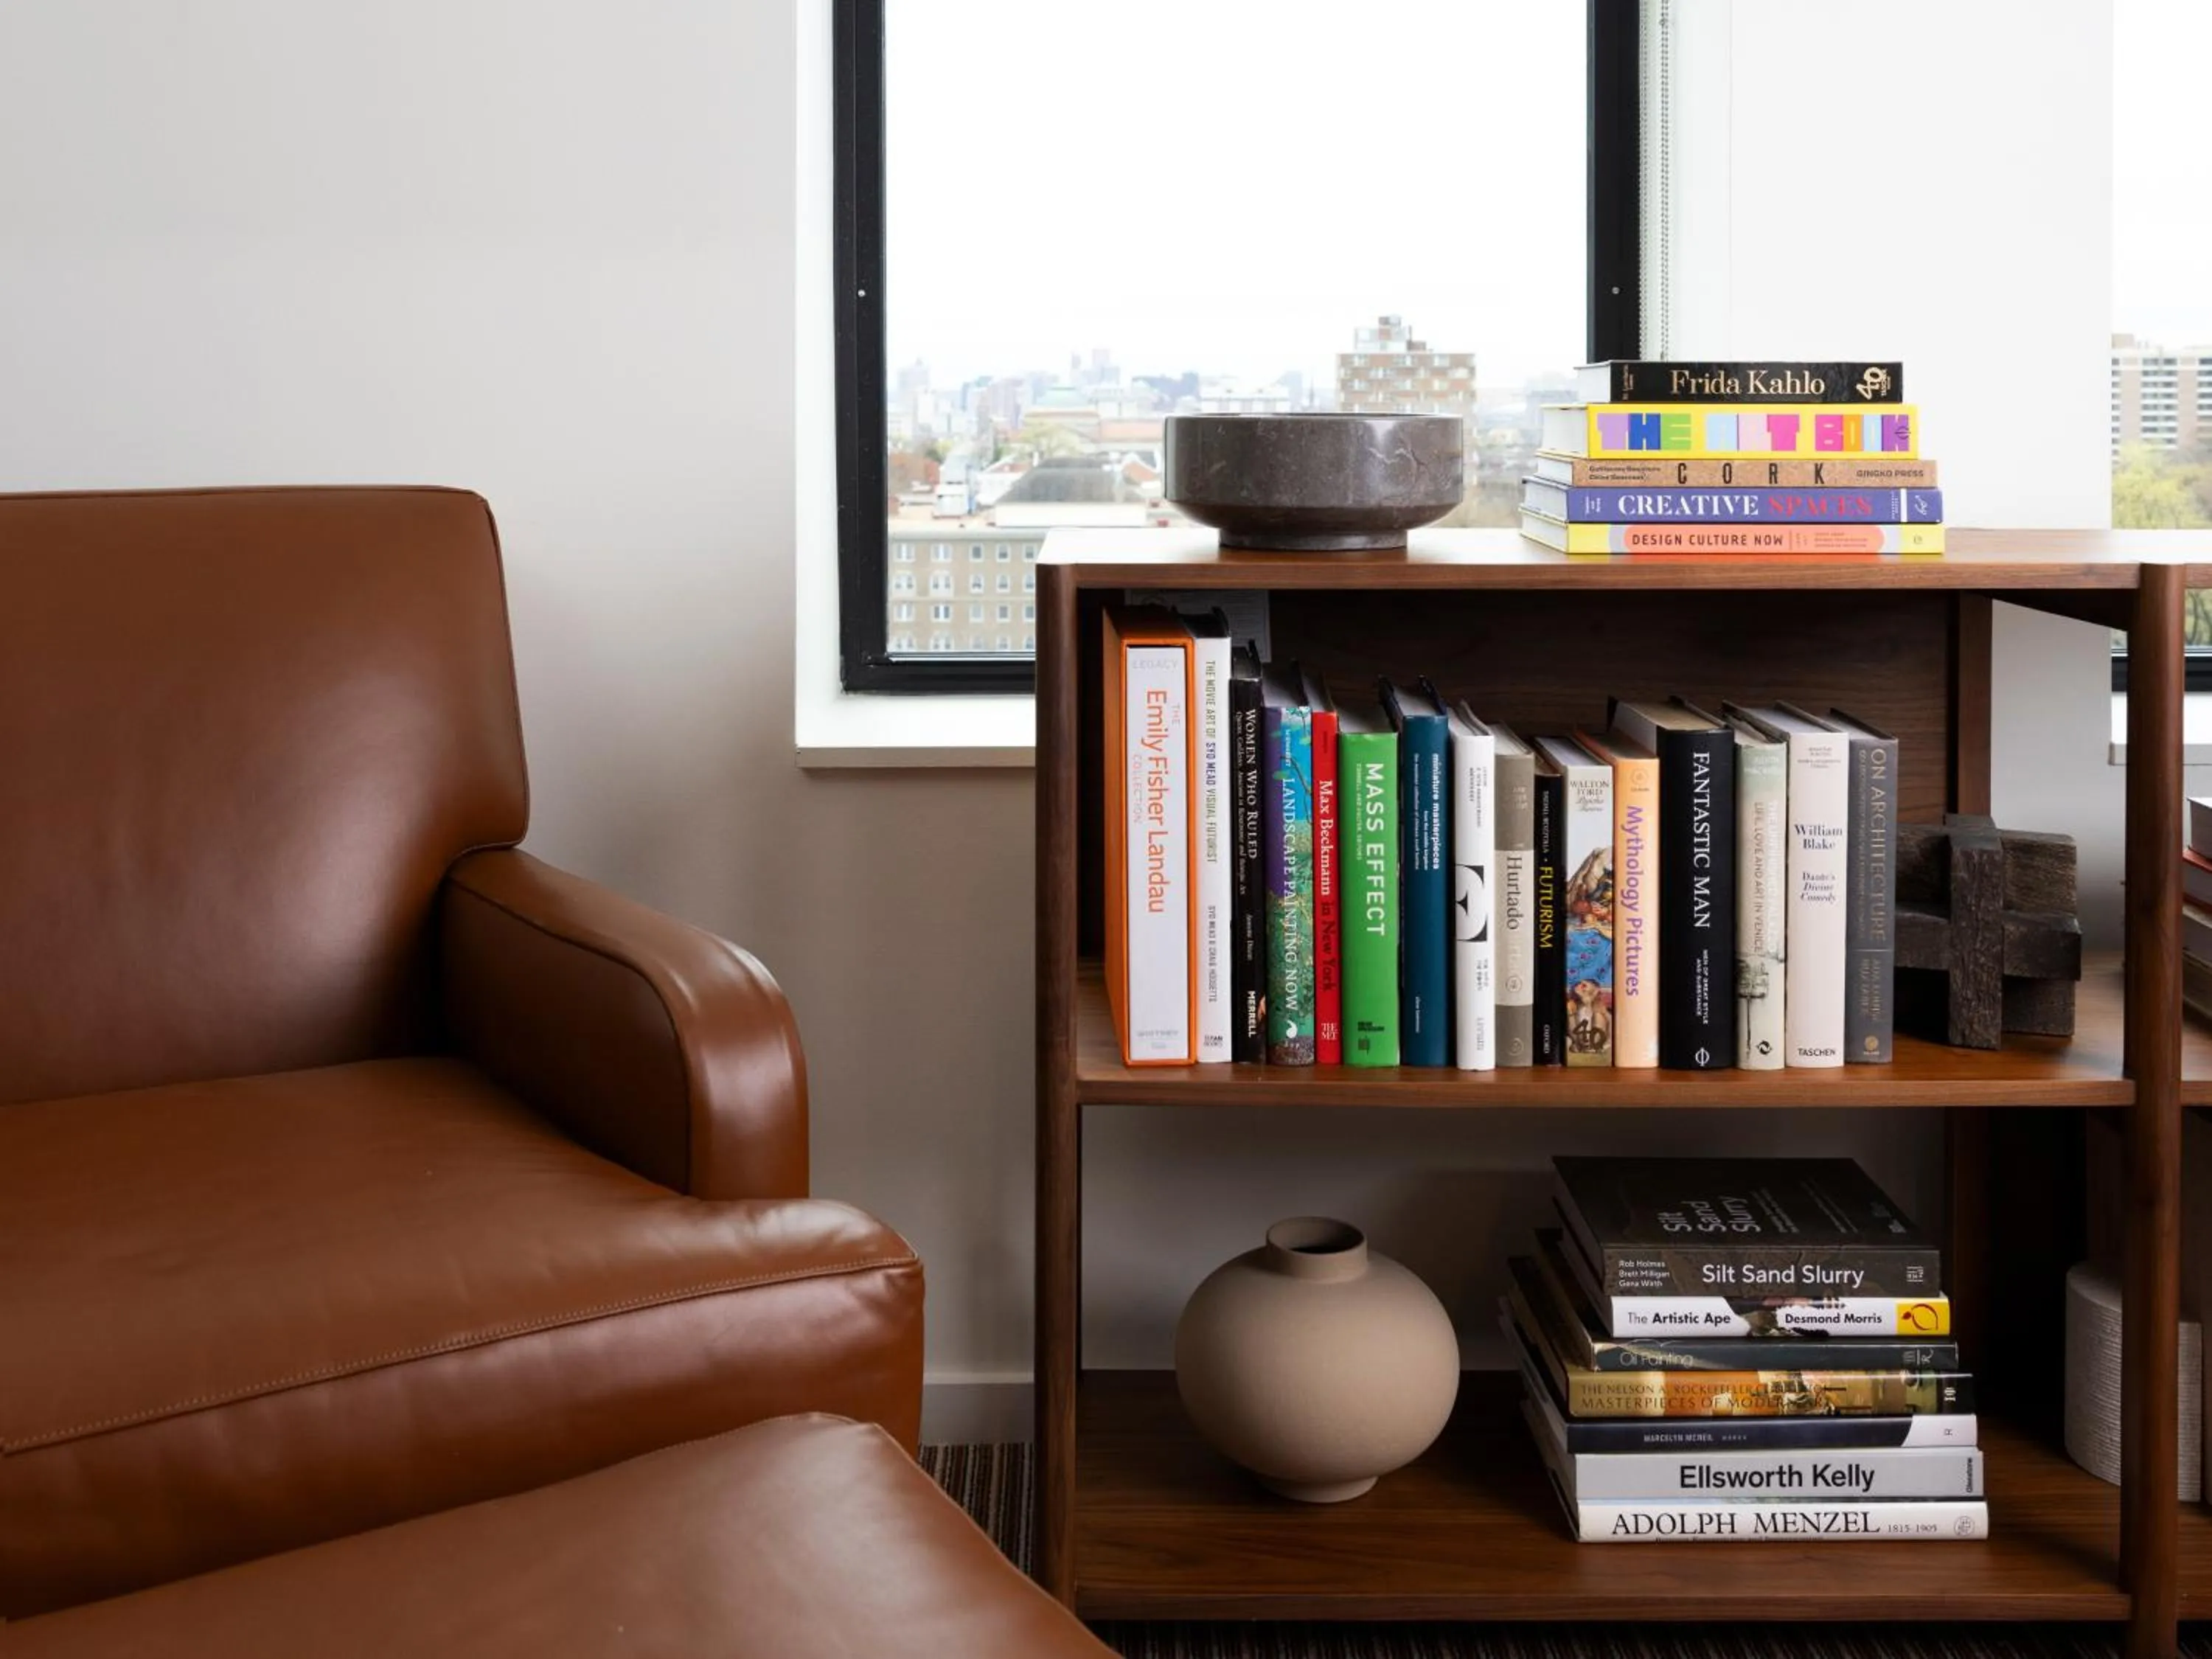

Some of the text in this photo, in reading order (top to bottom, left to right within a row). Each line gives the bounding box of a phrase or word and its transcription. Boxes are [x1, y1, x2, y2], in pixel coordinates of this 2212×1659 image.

[1669, 369, 1825, 394] Frida Kahlo
[1597, 413, 1909, 451] THE ART BOOK
[1895, 470, 1924, 478] PRESS
[1618, 495, 1759, 515] CREATIVE
[1768, 495, 1871, 515] SPACES
[1632, 535, 1783, 545] DESIGN CULTURE NOW
[1172, 705, 1180, 726] THE
[1206, 661, 1217, 863] THE MOVIE ART OF SYD MEAD VISUAL FUTURIST
[1245, 709, 1258, 859] WOMEN WHO RULED
[1570, 780, 1610, 788] WALTON
[1141, 690, 1171, 913] Emily Fisher Landau
[1283, 779, 1295, 874] LANDSCAPE
[1431, 803, 1439, 870] masterpieces
[1694, 752, 1711, 928] FANTASTIC MAN
[1794, 824, 1843, 836] William
[1366, 763, 1385, 936] MASS EFFECT
[1754, 828, 1765, 857] LOVE
[1803, 838, 1835, 849] Blake
[1871, 748, 1887, 942] ON ARCHITECTURE
[1620, 806, 1644, 912] Mythology
[1754, 858, 1765, 882] AND
[1320, 780, 1337, 992] Max Beckmann in New York
[1507, 857, 1523, 930] Hurtado
[1753, 883, 1764, 900] ART
[1801, 892, 1836, 903] Comedy
[1803, 883, 1834, 891] Divine
[1284, 880, 1297, 961] PAINTING
[1540, 866, 1554, 948] FUTURISM
[1753, 902, 1764, 911] IN
[1753, 914, 1764, 953] VENICE
[1627, 918, 1644, 996] Pictures
[1285, 964, 1298, 1011] NOW
[1248, 990, 1256, 1038] MERRELL
[1798, 1048, 1835, 1056] TASCHEN
[1658, 1211, 1692, 1232] Silt
[1681, 1200, 1727, 1232] Sand
[1719, 1195, 1761, 1232] Slurry
[1640, 1270, 1670, 1279] Milligan
[1702, 1264, 1864, 1289] Silt Sand Slurry
[1628, 1312, 1882, 1326] The Artistic Ape Desmond Morris
[1580, 1384, 1602, 1395] THE
[1607, 1384, 1654, 1394] NELSON
[1674, 1383, 1750, 1395] ROCKEFELLER
[1579, 1397, 1696, 1410] MASTERPIECES
[1701, 1397, 1720, 1410] OF
[1728, 1397, 1795, 1410] MODER
[1680, 1464, 1875, 1492] Ellsworth Kelly
[1612, 1512, 1736, 1535] ADOLPH
[1753, 1511, 1881, 1534] MENZEL
